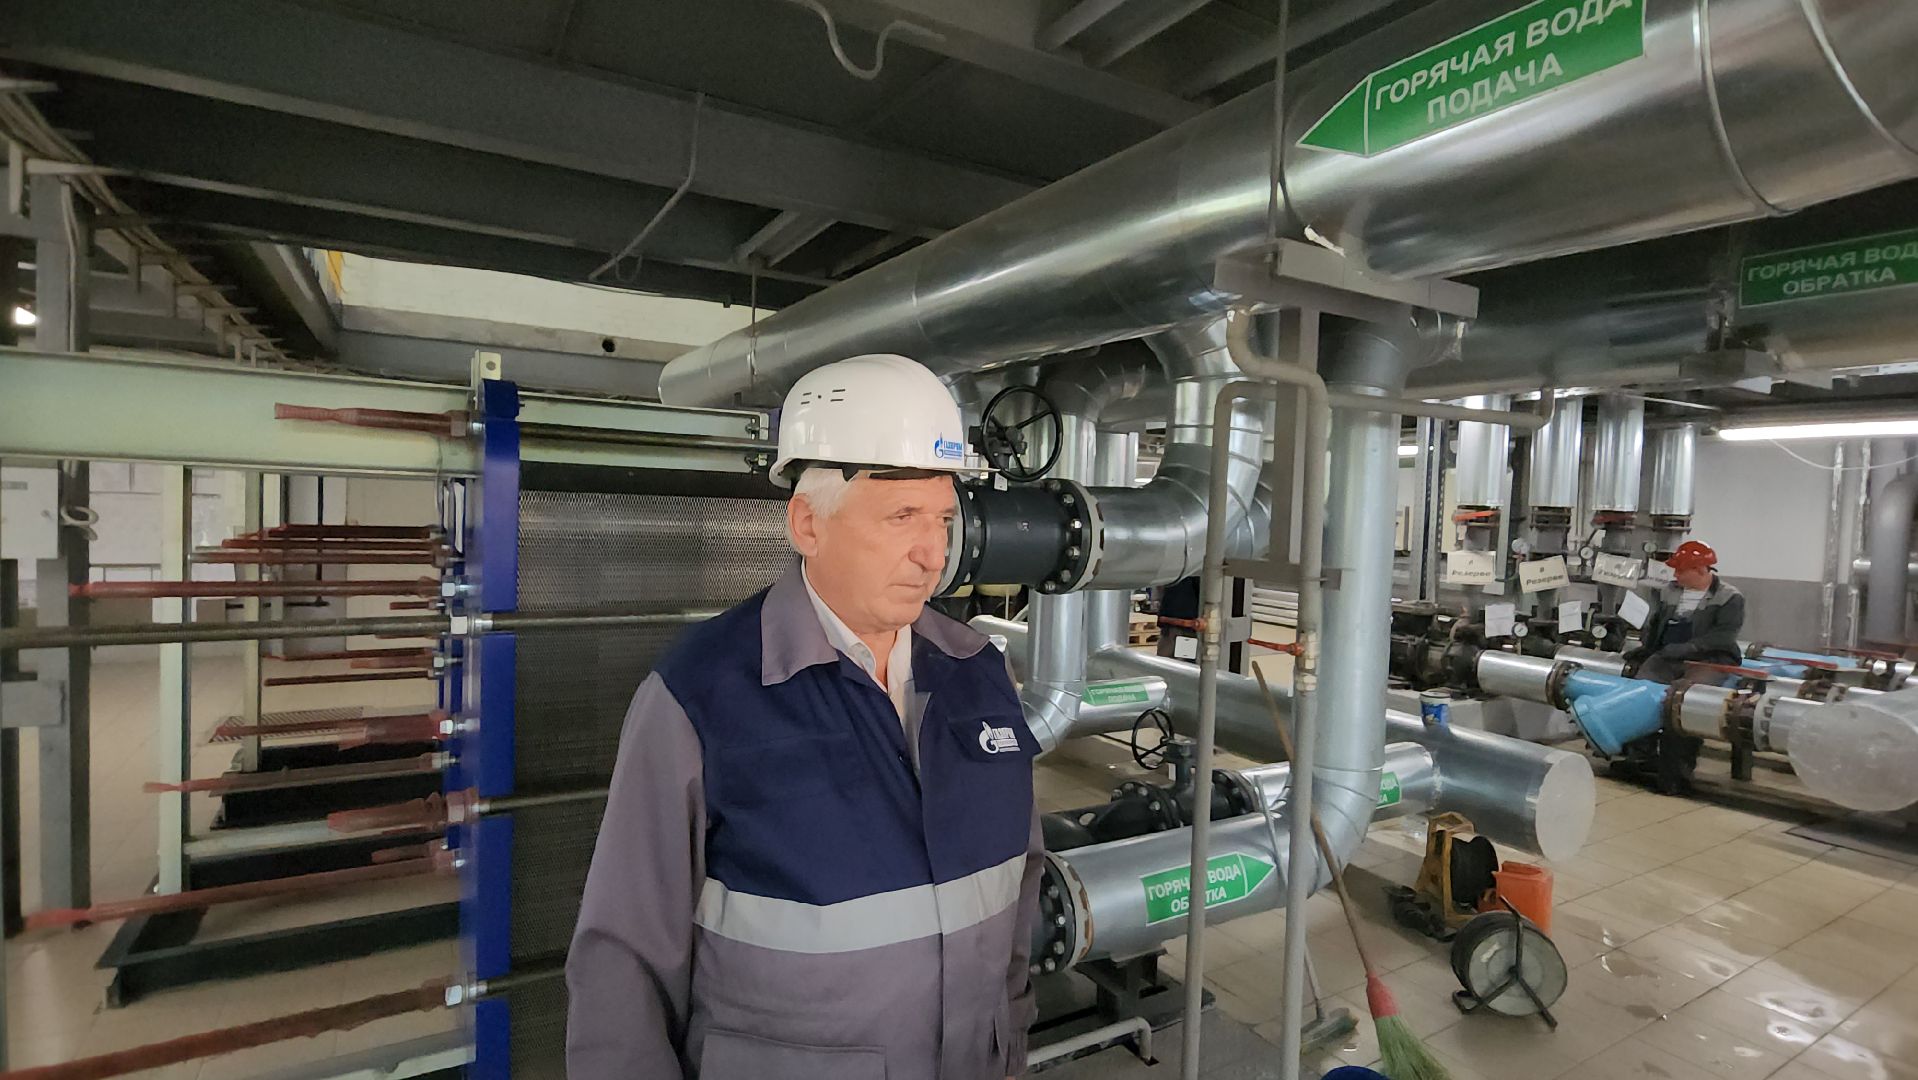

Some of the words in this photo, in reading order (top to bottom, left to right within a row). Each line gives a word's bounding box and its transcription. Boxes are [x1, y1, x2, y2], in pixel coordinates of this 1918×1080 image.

[1375, 30, 1516, 111] ГОРЯЧАЯ
[1427, 51, 1564, 124] ПОДАЧА
[1747, 250, 1857, 282] ГОРЯЧАЯ
[1782, 266, 1897, 295] ОБРАТКА
[1148, 877, 1191, 900] ГОРЯЧ
[1207, 863, 1241, 884] ВОДА
[1170, 886, 1227, 913] ОБТКА
